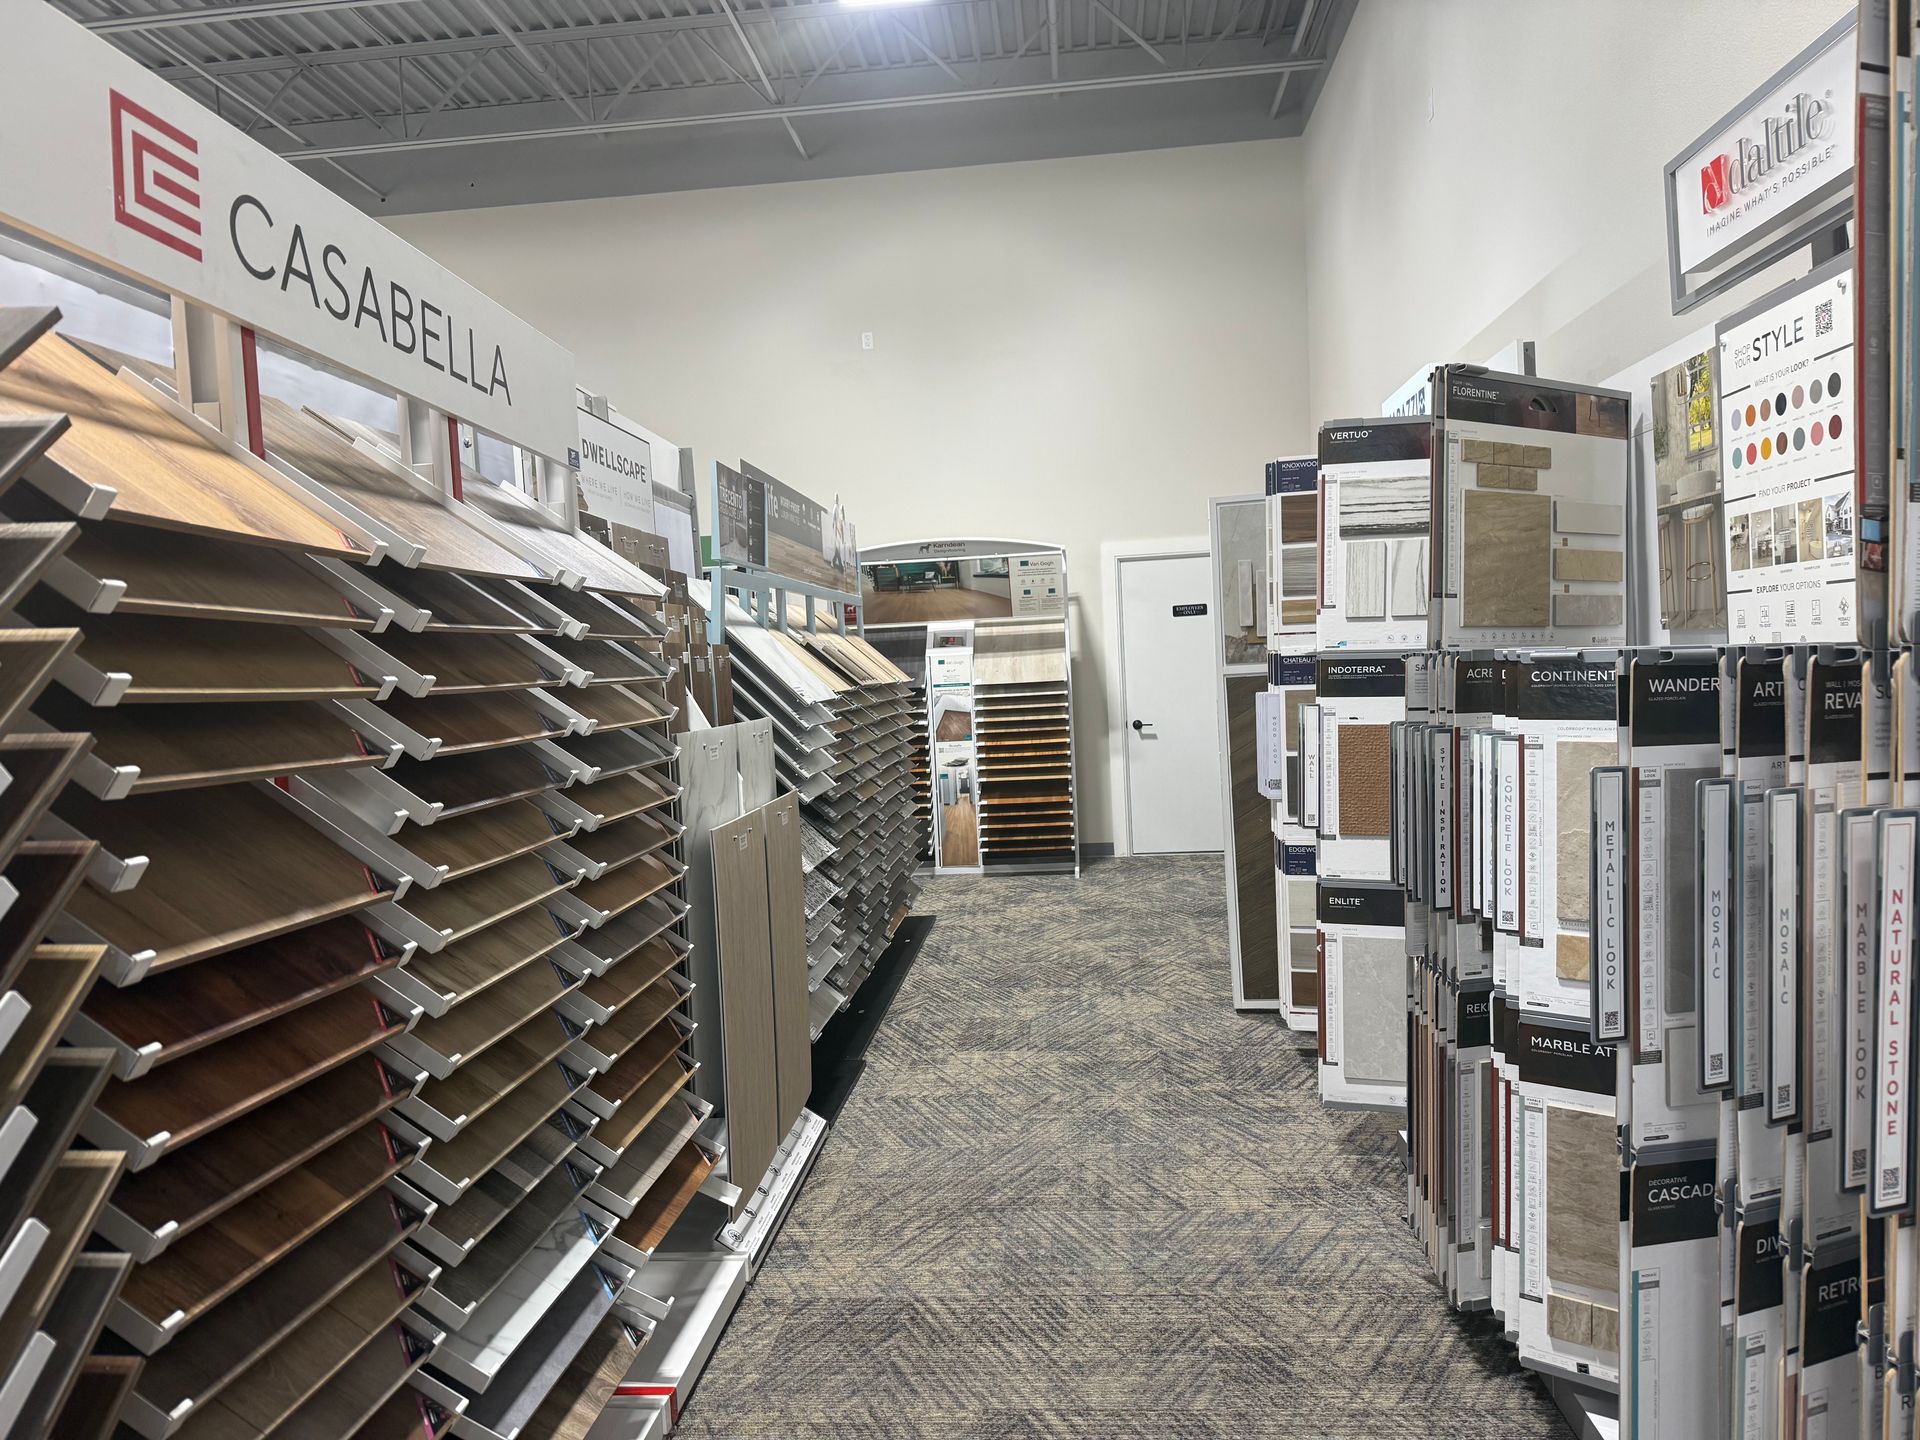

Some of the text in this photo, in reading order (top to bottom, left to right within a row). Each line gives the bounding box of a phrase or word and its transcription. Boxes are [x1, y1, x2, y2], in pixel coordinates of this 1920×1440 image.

[1728, 92, 1823, 194] daltile
[1706, 149, 1831, 238] IMAGINE WHAT'S POSSIBLE
[229, 194, 512, 407] CASABELLA
[1752, 316, 1804, 362] STYLE
[1734, 344, 1751, 359] SHOP
[1734, 355, 1751, 369] YOUR
[1775, 366, 1790, 379] YOUR
[1790, 359, 1809, 373] LOOK?
[1452, 386, 1497, 400] FLORENTINE
[1330, 431, 1368, 440] VERTUO
[581, 438, 647, 483] DWELLSCAPE
[1758, 478, 1811, 498] FIND YOUR PROJECT
[1756, 579, 1821, 594] EXPLORE YOUR OPTIONS
[1328, 666, 1382, 674] INDOTERRA
[1531, 670, 1616, 682] CONTINENT
[1648, 677, 1720, 693] WANDER
[1308, 753, 1316, 779] WALL
[1504, 775, 1513, 896] CONCRETE LOOK
[1329, 896, 1360, 905] ENLITE
[1605, 821, 1616, 990] METALLIC LOOK
[1711, 889, 1721, 980] MOSAIC
[1779, 907, 1789, 1006] MOSAIC
[1855, 903, 1868, 1100] MARBLE LOOK
[1887, 889, 1904, 1137] NATURAL STONE
[1531, 1036, 1591, 1054] MARBLE
[1648, 1176, 1687, 1187] DECORATIVE
[1648, 1183, 1714, 1203] CASCAD
[1818, 1276, 1862, 1303] RETR
